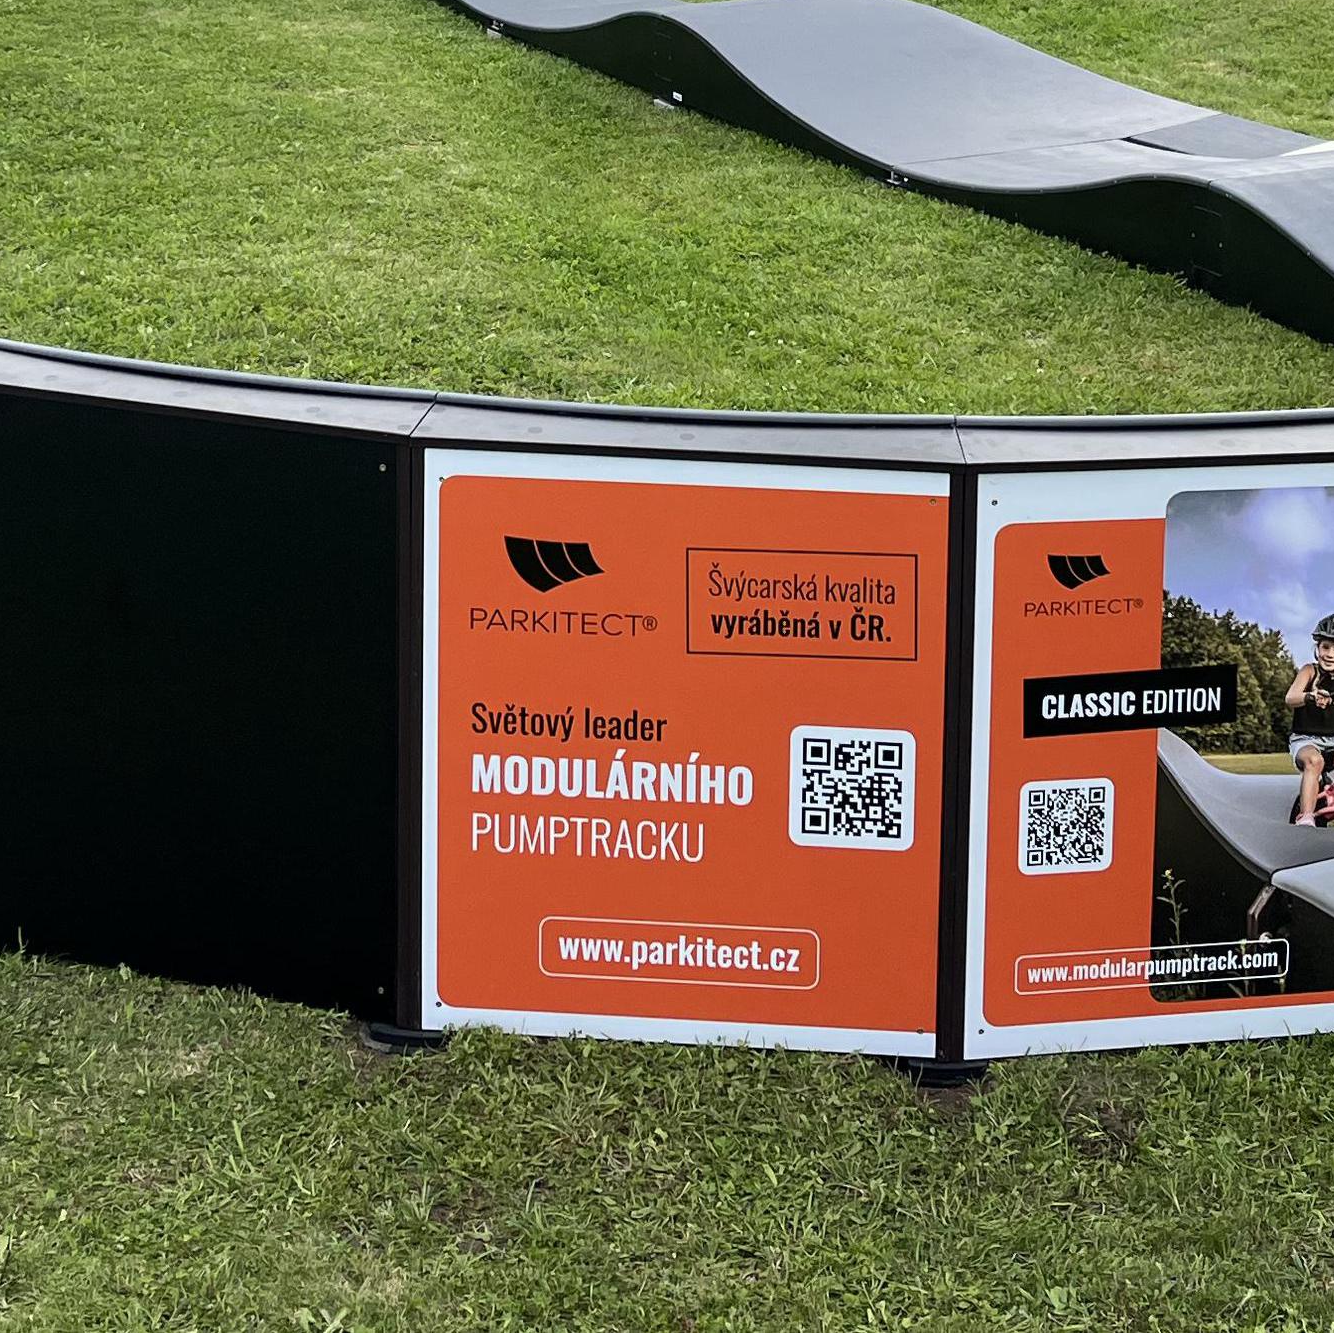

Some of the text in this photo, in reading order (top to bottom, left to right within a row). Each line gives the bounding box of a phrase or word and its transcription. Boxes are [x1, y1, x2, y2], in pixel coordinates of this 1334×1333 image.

[708, 563, 896, 605] Švýcarská kvalita
[711, 606, 892, 642] vyráběná v ČR.
[471, 703, 668, 743] Světový leader
[1041, 686, 1222, 720] CLASSIC EDITION
[471, 749, 754, 806] MODULÁRNÍHO
[471, 812, 705, 863] PUMPTRACKU
[558, 933, 800, 973] www.parkitect.cz
[1027, 947, 1279, 985] www.modularpumptrack.com
